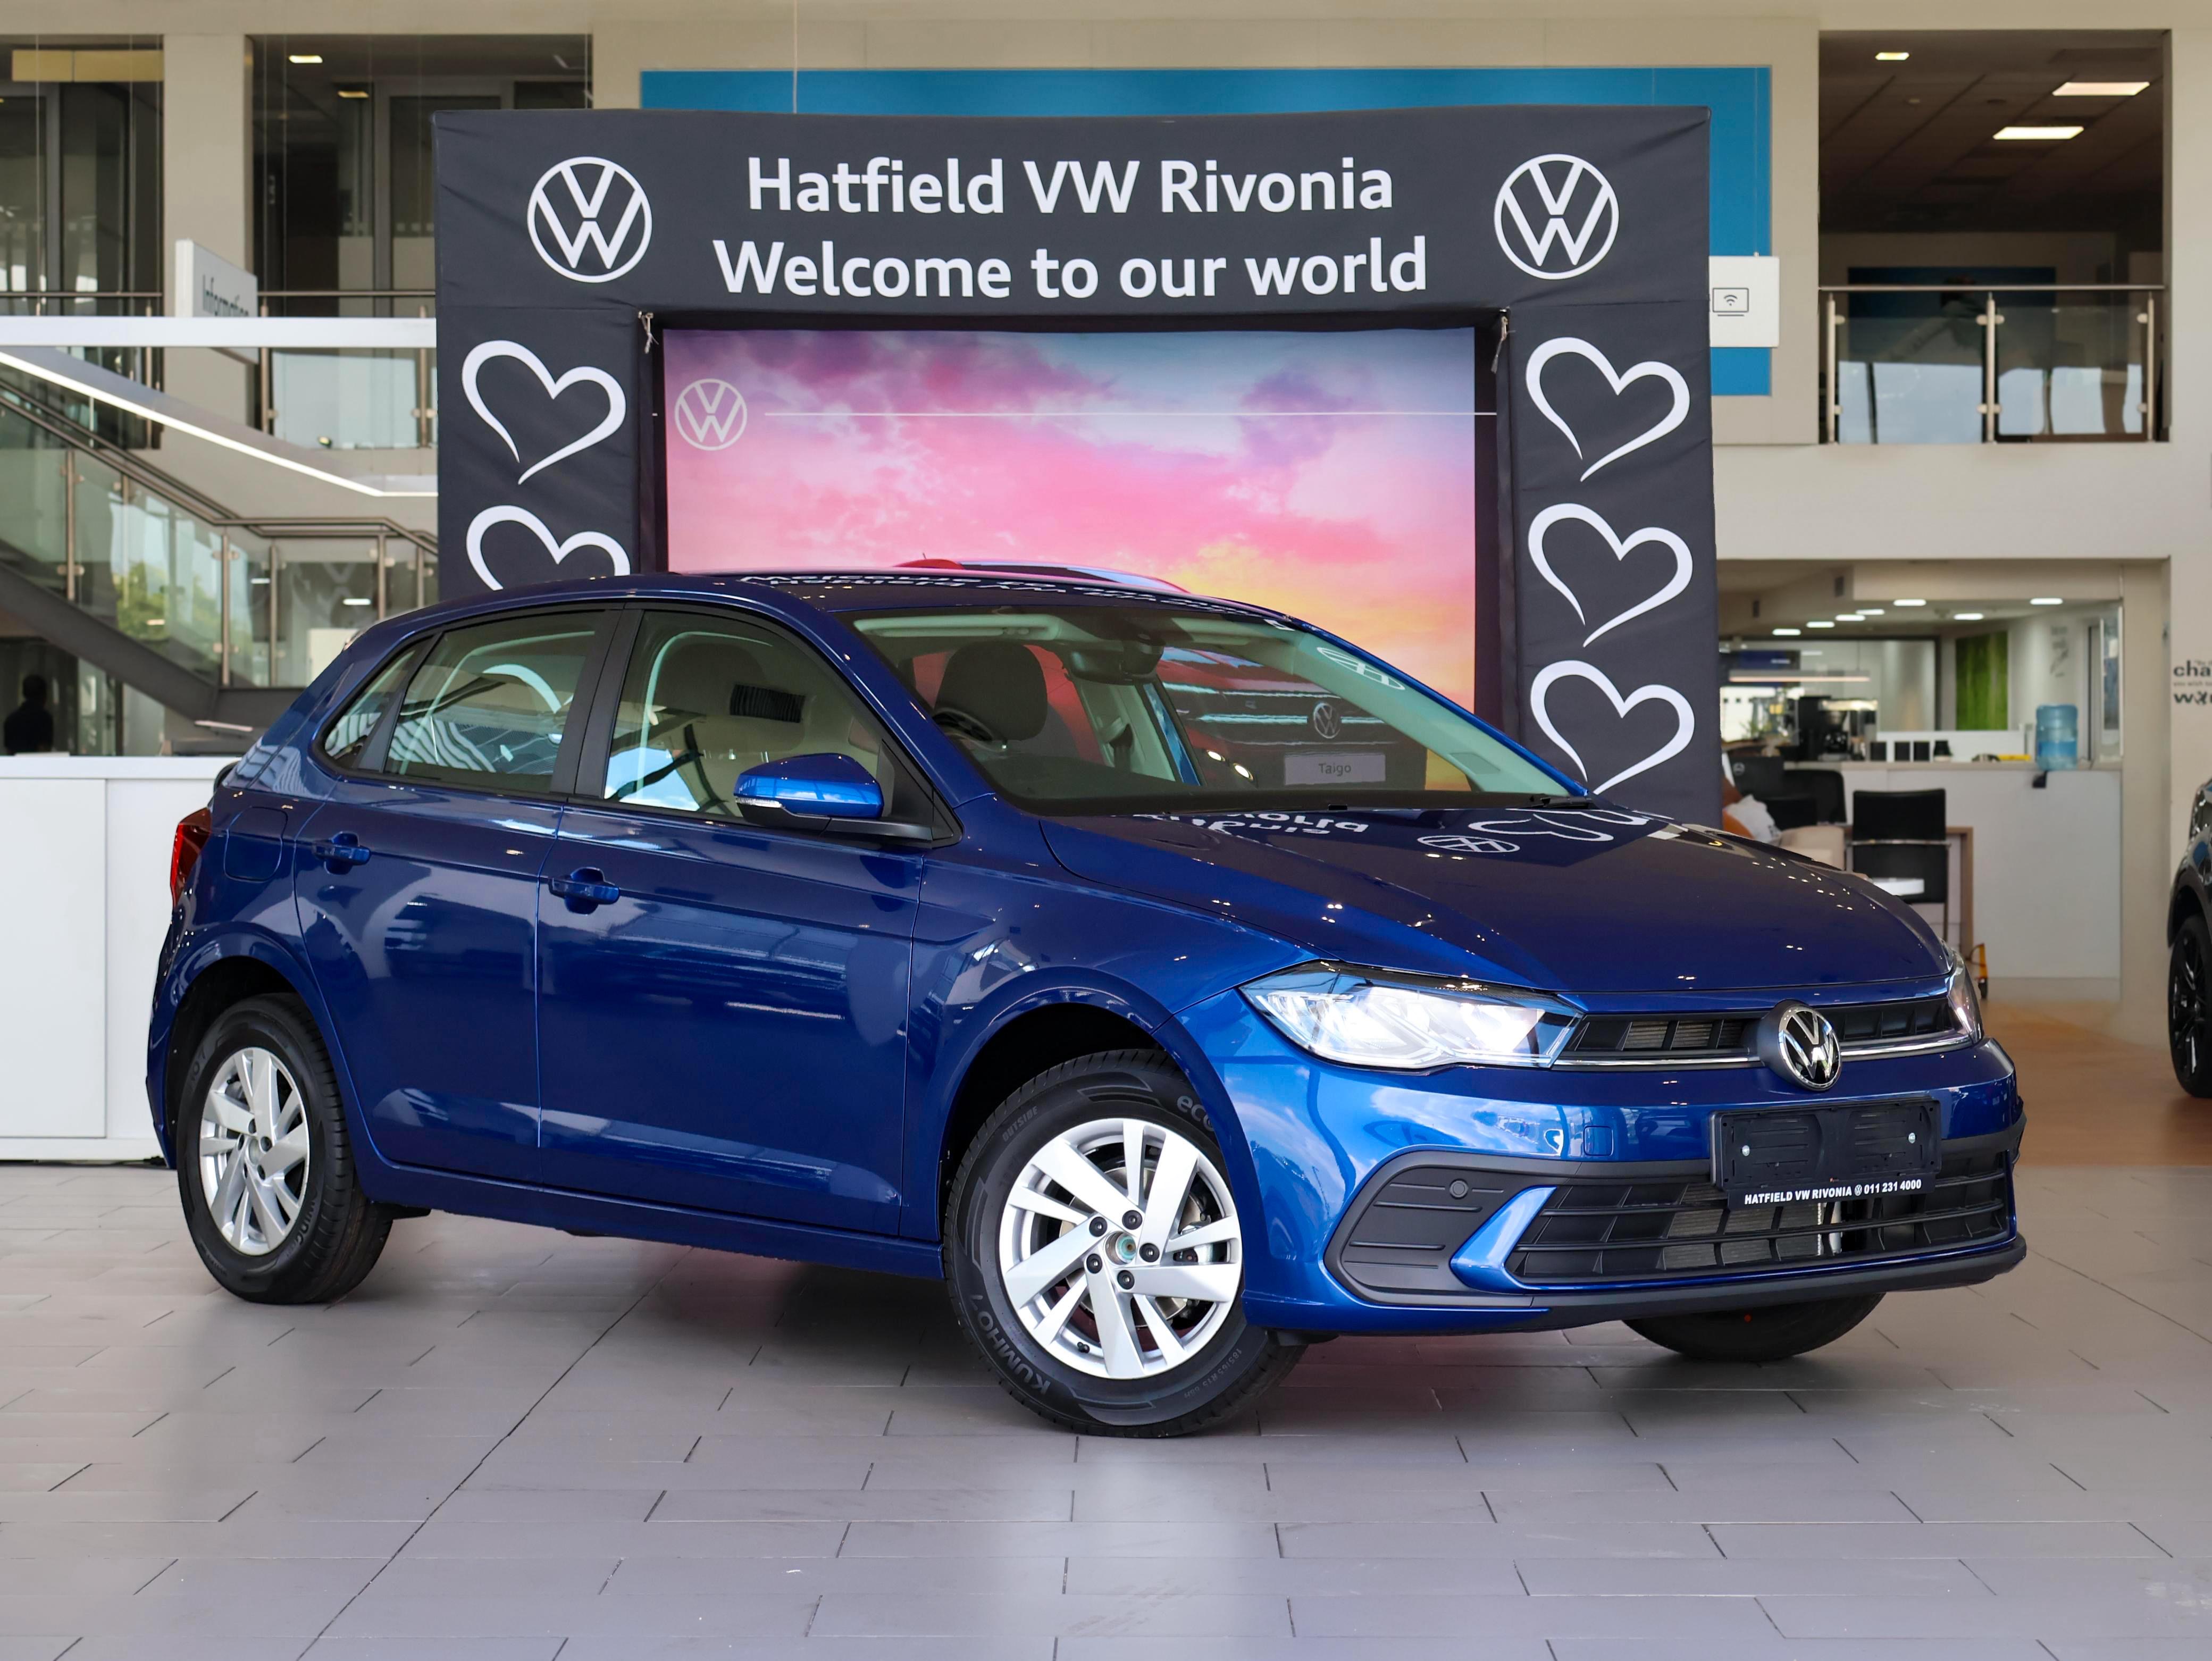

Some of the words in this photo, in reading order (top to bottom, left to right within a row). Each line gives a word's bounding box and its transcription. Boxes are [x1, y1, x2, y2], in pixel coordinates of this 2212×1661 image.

[749, 157, 1003, 214] Hatfield
[1023, 161, 1139, 213] VW
[1162, 157, 1392, 212] Rivonia
[1494, 154, 1619, 280] VW
[527, 156, 652, 283] VW
[713, 240, 1011, 298] Welcome
[1032, 249, 1097, 298] to
[1120, 258, 1226, 297] our
[1245, 236, 1426, 295] world
[674, 378, 748, 451] VW
[1318, 762, 1352, 777] Taigo
[1779, 1006, 1841, 1090] VW
[1002, 1105, 1038, 1142] OUTSIDE
[1744, 1191, 1793, 1205] HATFIELD
[1795, 1189, 1811, 1201] VW
[1812, 1186, 1853, 1199] RIVONIA
[1864, 1182, 1880, 1195] 011
[1882, 1181, 1898, 1193] 231
[1899, 1178, 1922, 1191] 4000
[977, 1311, 1051, 1395] KUMHO
